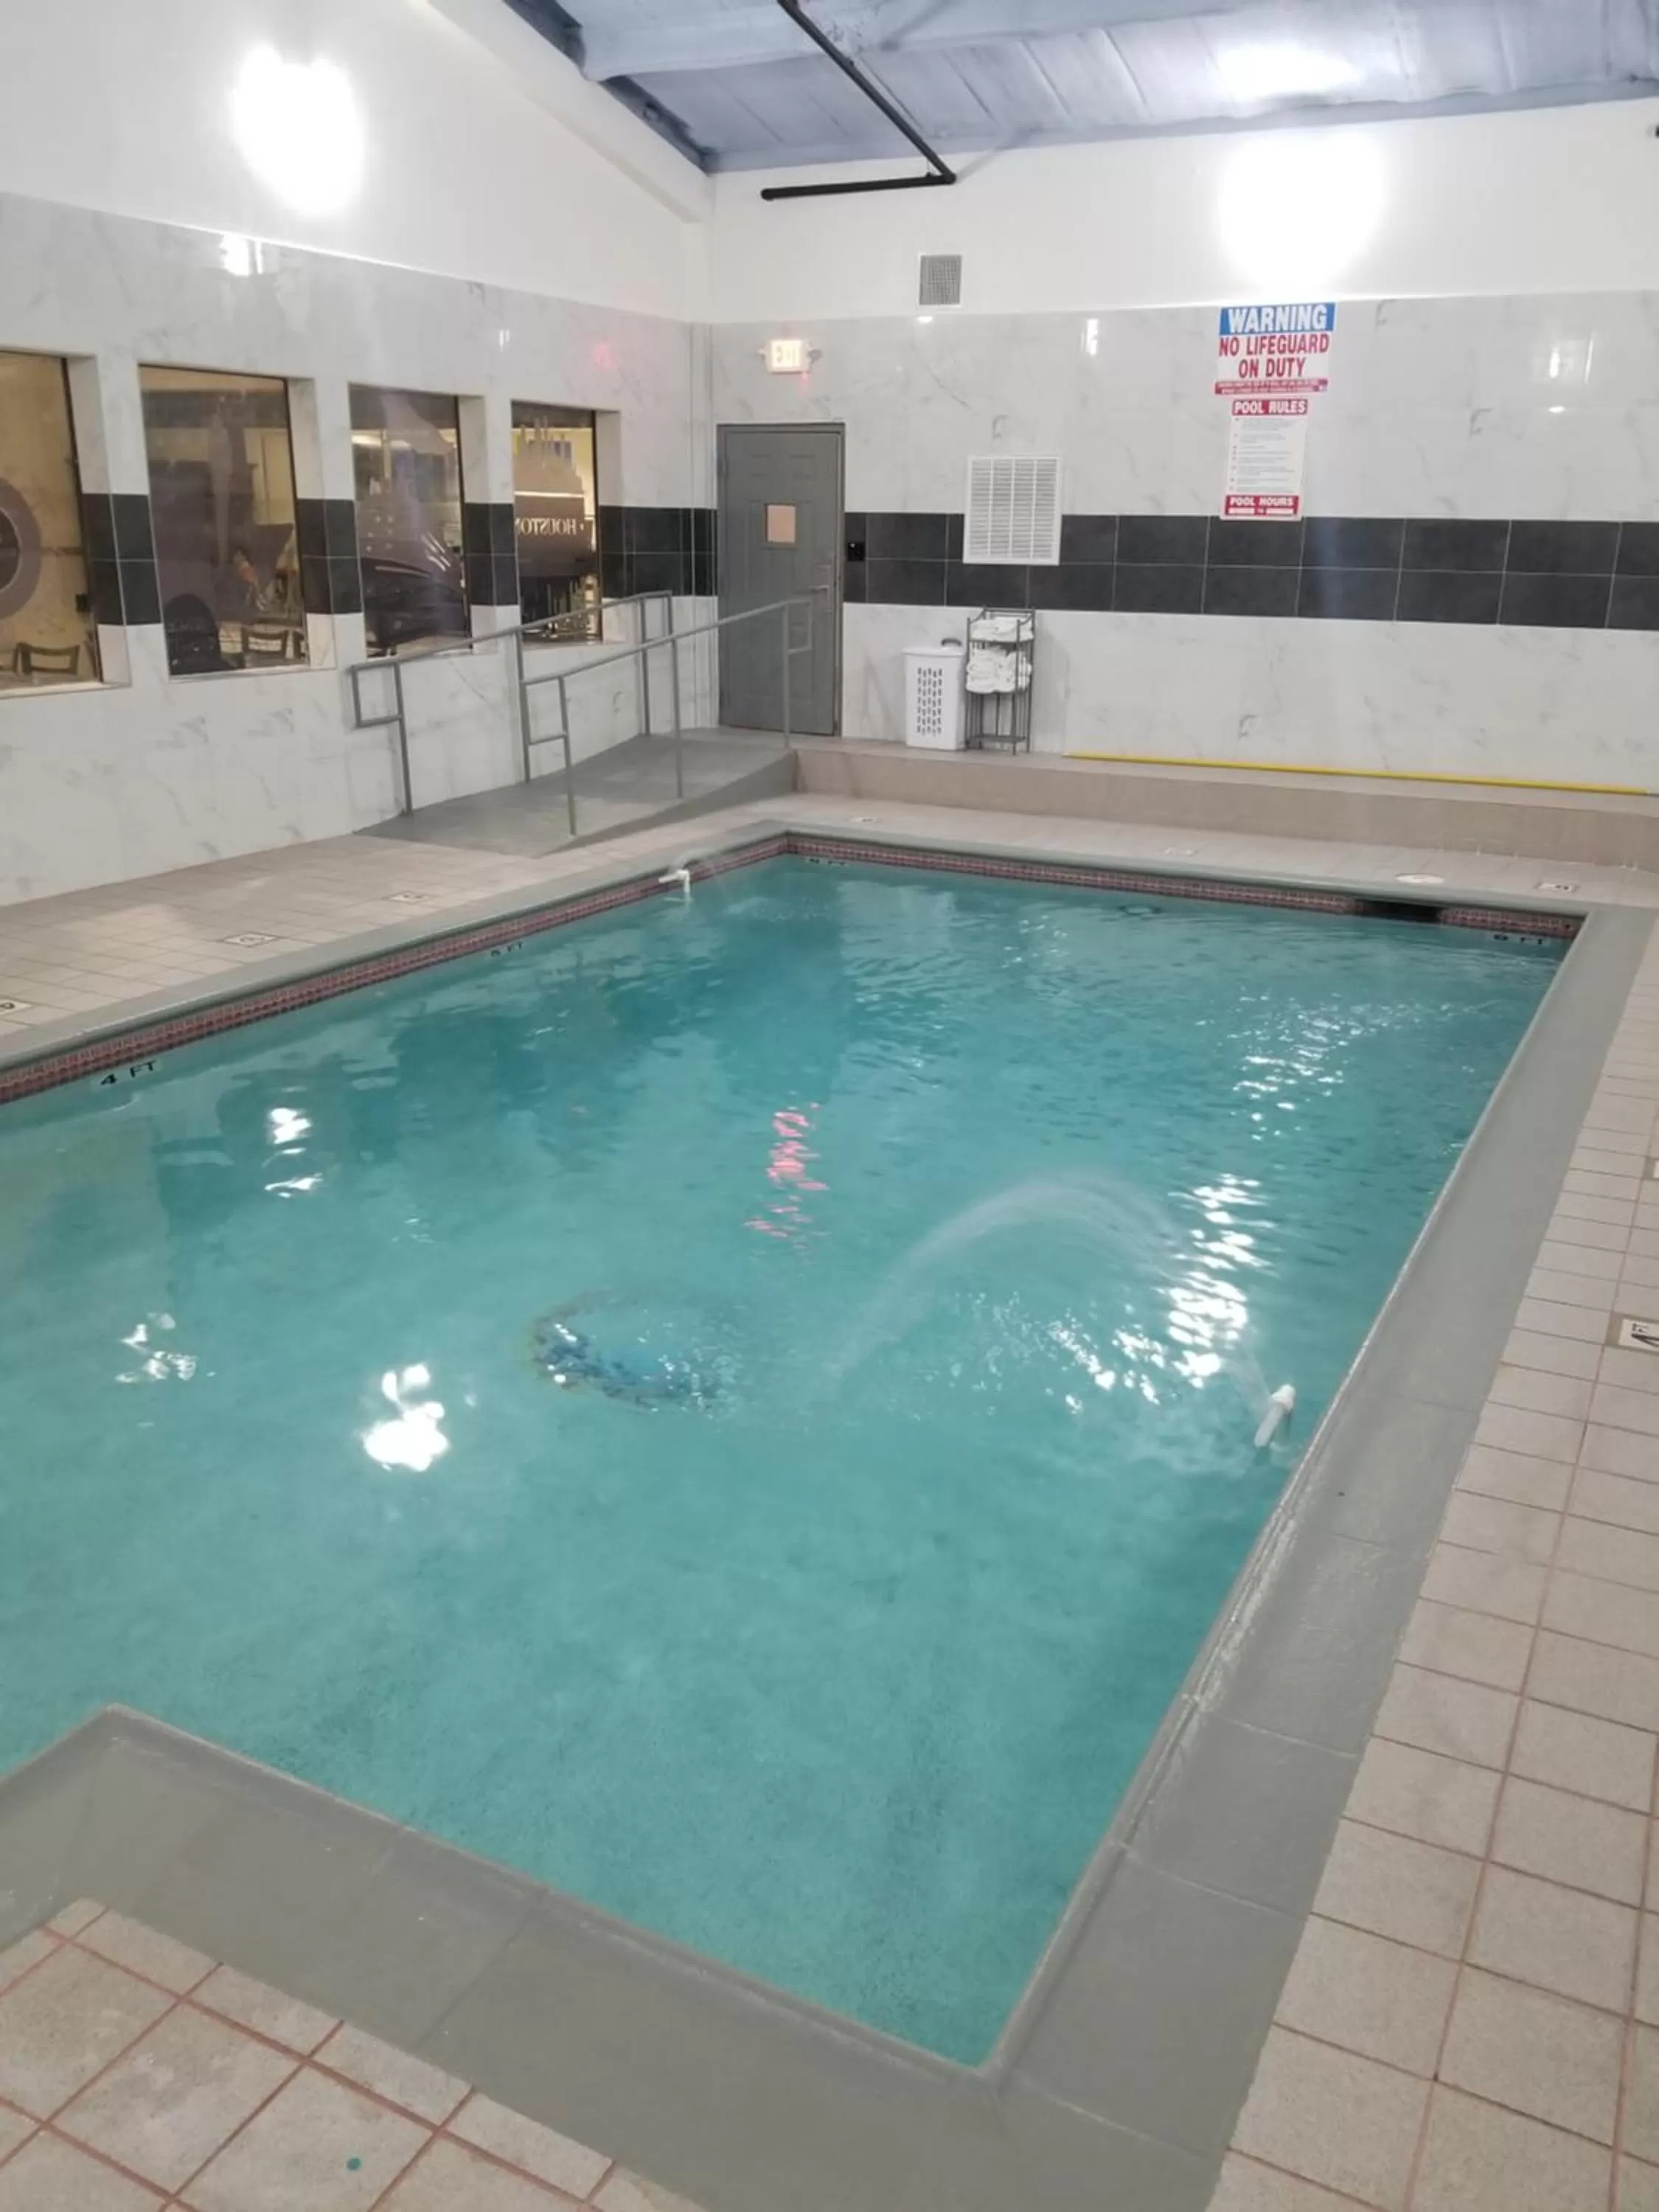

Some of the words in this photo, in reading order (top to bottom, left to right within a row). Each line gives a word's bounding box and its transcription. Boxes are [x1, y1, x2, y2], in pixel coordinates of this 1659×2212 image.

[1228, 305, 1327, 333] WARNING
[1219, 337, 1240, 356] NO
[1246, 333, 1330, 355] LIFEGUARD
[1238, 358, 1260, 378] ON
[1265, 357, 1306, 378] DUTY
[1234, 401, 1265, 414] POOL
[1268, 400, 1306, 414] RULES
[101, 1074, 116, 1085] 4
[130, 1060, 157, 1078] FT
